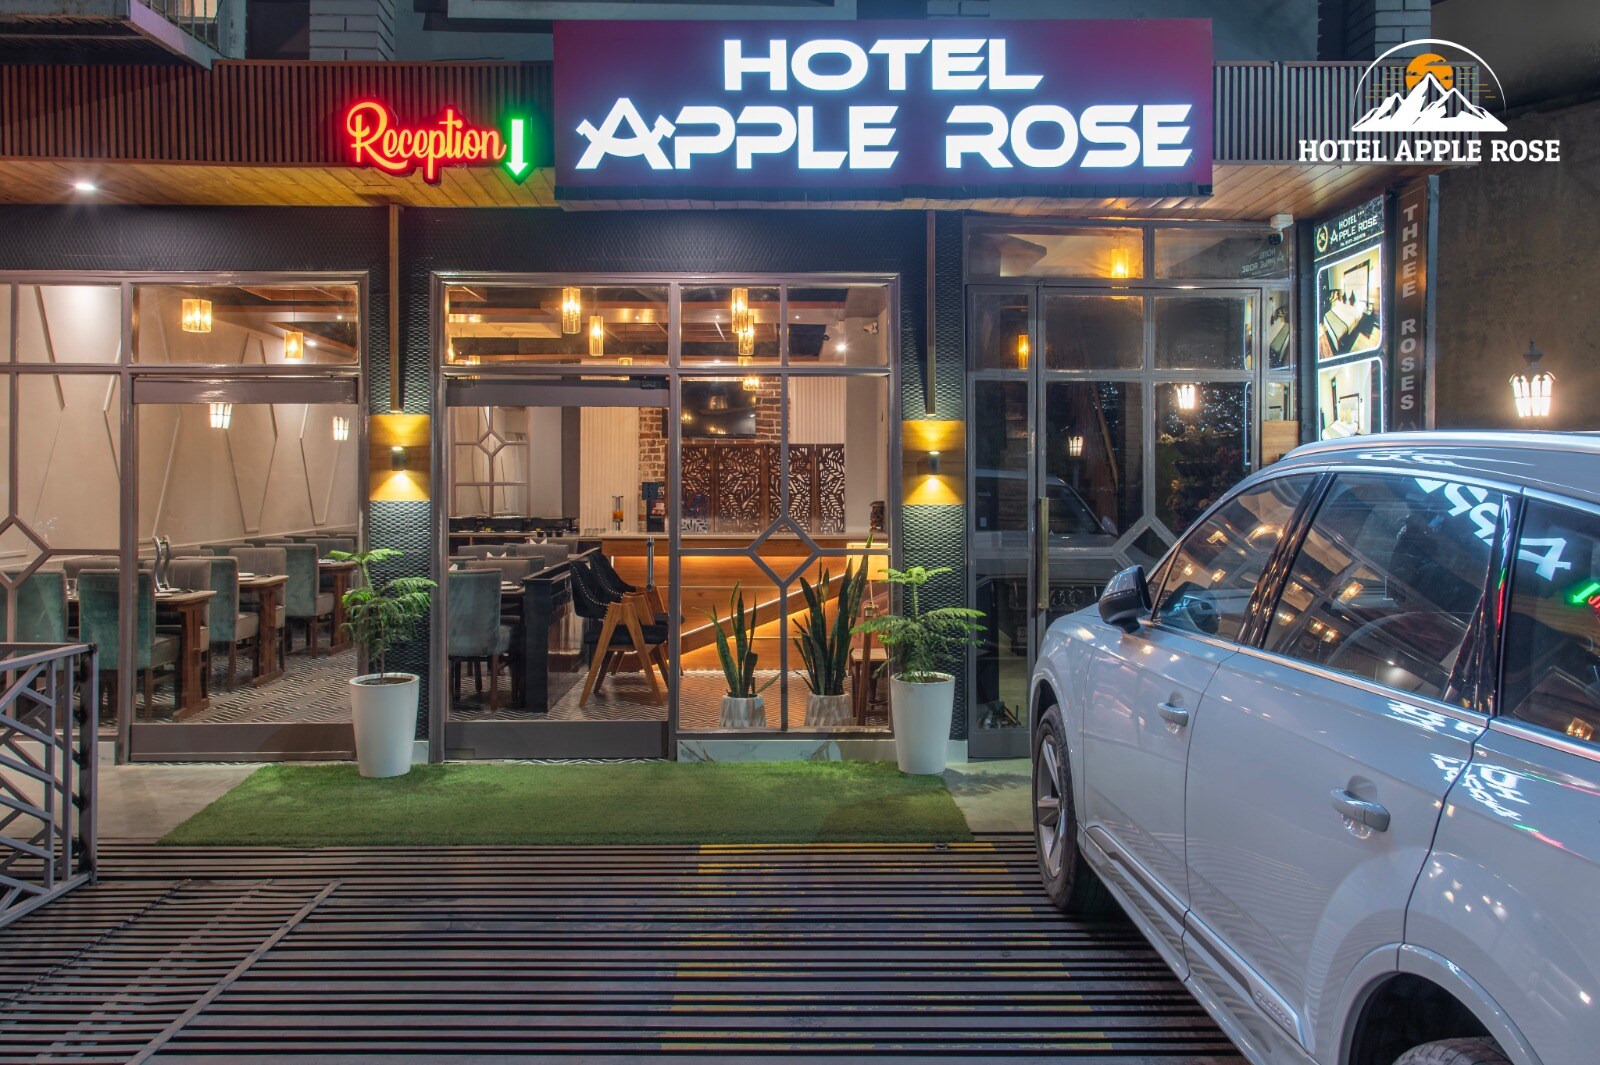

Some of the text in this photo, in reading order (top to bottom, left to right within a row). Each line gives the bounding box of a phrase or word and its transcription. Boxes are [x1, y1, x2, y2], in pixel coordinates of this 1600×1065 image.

[724, 38, 1044, 91] HOTEL
[346, 101, 507, 179] Reception
[575, 97, 1193, 169] APPLE ROSE
[1330, 225, 1357, 245] APPLE
[1358, 214, 1378, 232] ROSE
[1338, 214, 1357, 230] HOTEL
[1400, 203, 1418, 410] THREE ROSES
